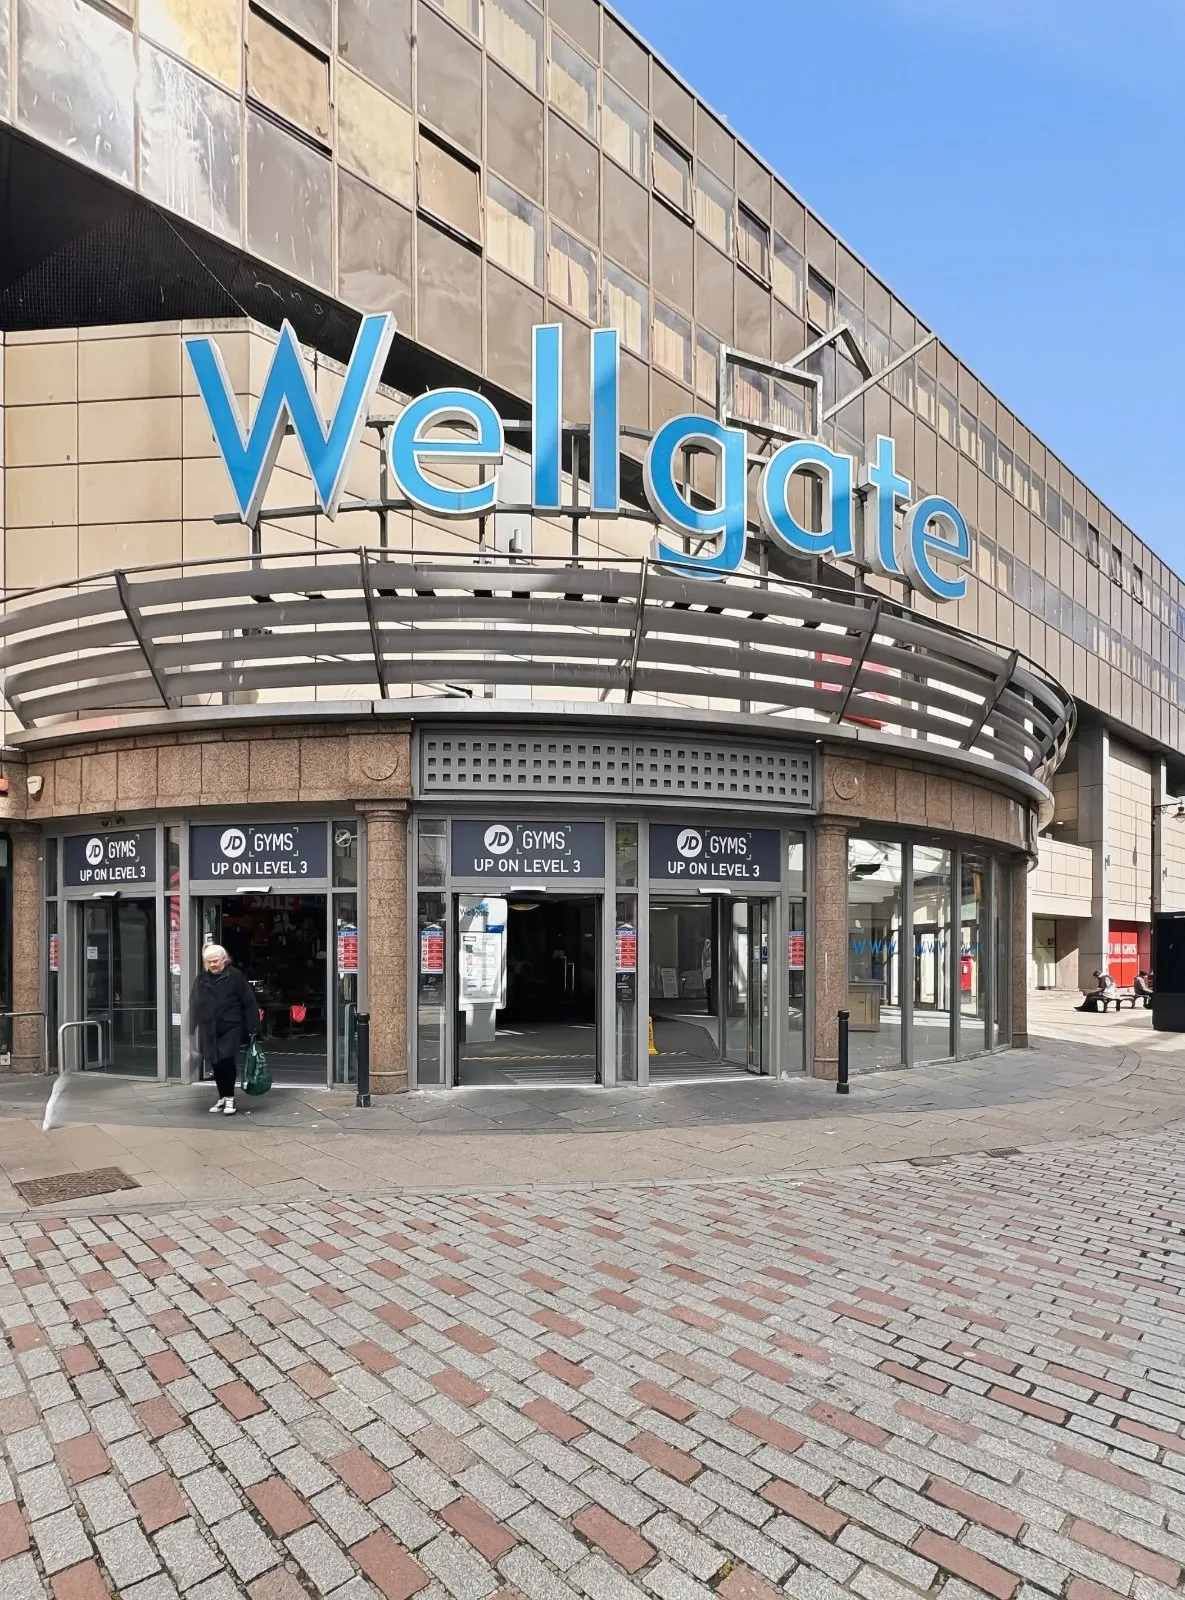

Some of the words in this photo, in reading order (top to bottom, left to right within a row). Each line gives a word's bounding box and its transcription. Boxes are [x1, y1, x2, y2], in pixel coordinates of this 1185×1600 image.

[184, 311, 971, 603] Wellgate
[254, 833, 293, 852] GYMS
[522, 830, 565, 849] GYMS
[710, 836, 747, 854] GYMS
[108, 840, 136, 859] GYMS
[80, 870, 92, 882] UP
[94, 868, 107, 880] ON
[109, 866, 138, 880] LEVEL
[140, 866, 146, 878] 3
[211, 862, 230, 875] UP
[233, 862, 251, 874] ON
[255, 861, 297, 874] LEVEL
[300, 861, 308, 874] 3
[474, 858, 494, 872] UP
[498, 859, 519, 872] ON
[524, 859, 569, 872] LEVEL
[573, 860, 581, 872] 3
[667, 861, 686, 874] UP
[689, 862, 707, 875] ON
[711, 863, 750, 876] LEVEL
[753, 865, 760, 877] 3
